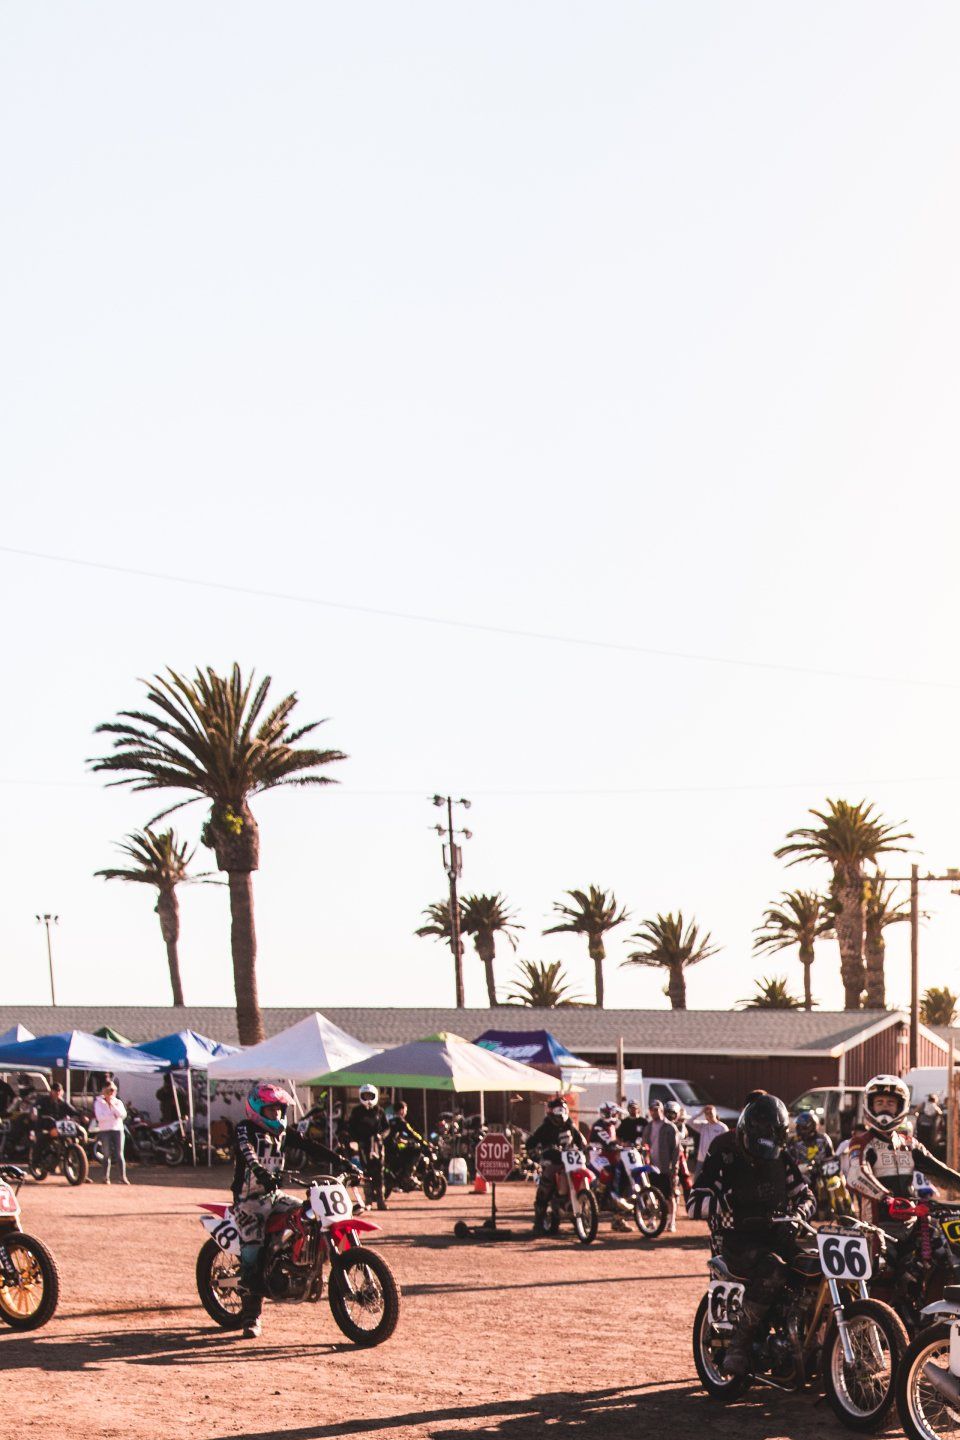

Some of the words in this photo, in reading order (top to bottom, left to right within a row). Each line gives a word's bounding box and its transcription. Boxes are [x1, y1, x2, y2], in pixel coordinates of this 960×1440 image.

[480, 1143, 510, 1159] STOP
[567, 1151, 582, 1165] 62
[318, 1190, 347, 1217] 18
[210, 1220, 238, 1250] 18
[822, 1237, 867, 1278] 66
[711, 1284, 743, 1326] 66
